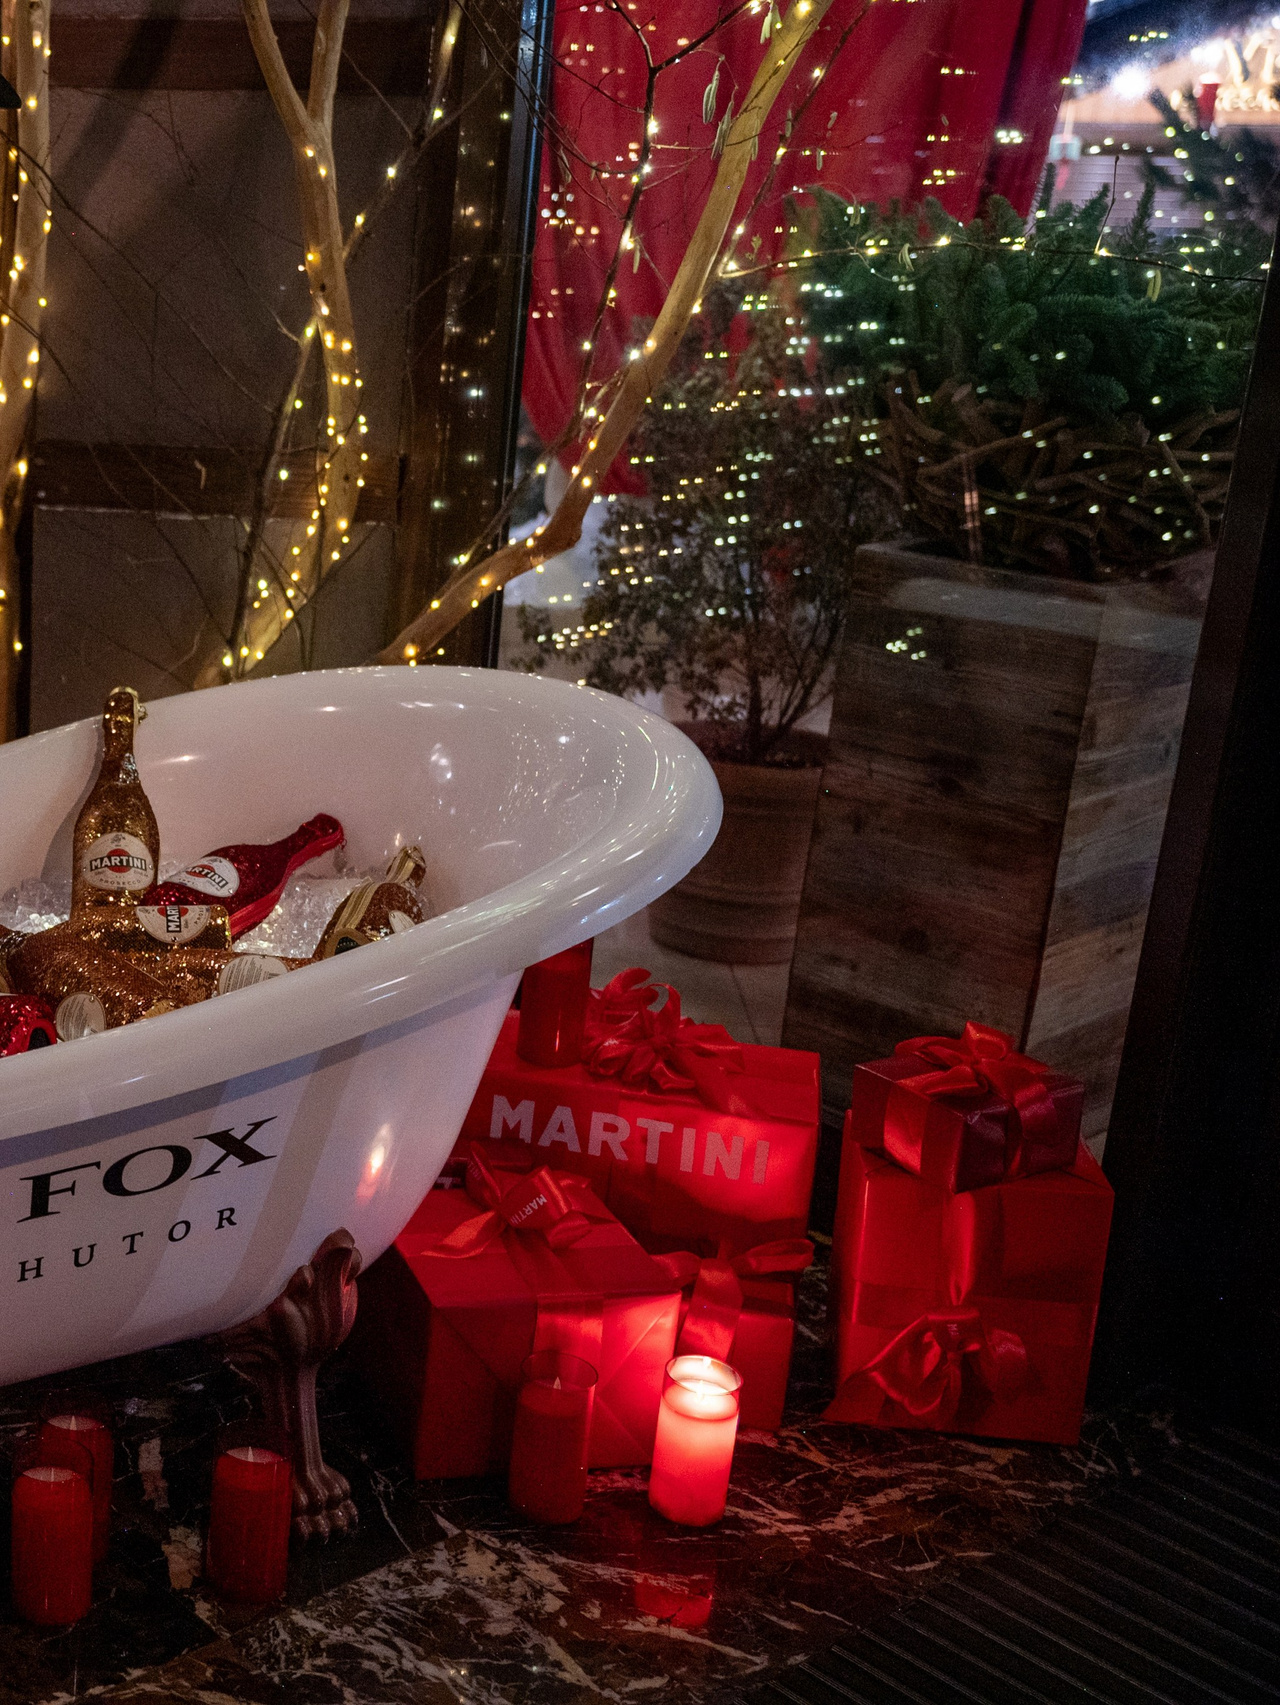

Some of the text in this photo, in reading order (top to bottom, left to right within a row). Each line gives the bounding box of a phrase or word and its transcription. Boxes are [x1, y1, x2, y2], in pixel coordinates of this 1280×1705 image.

[91, 856, 146, 870] MARTINI
[16, 1115, 278, 1224] FOX
[489, 1094, 770, 1185] MARTINI
